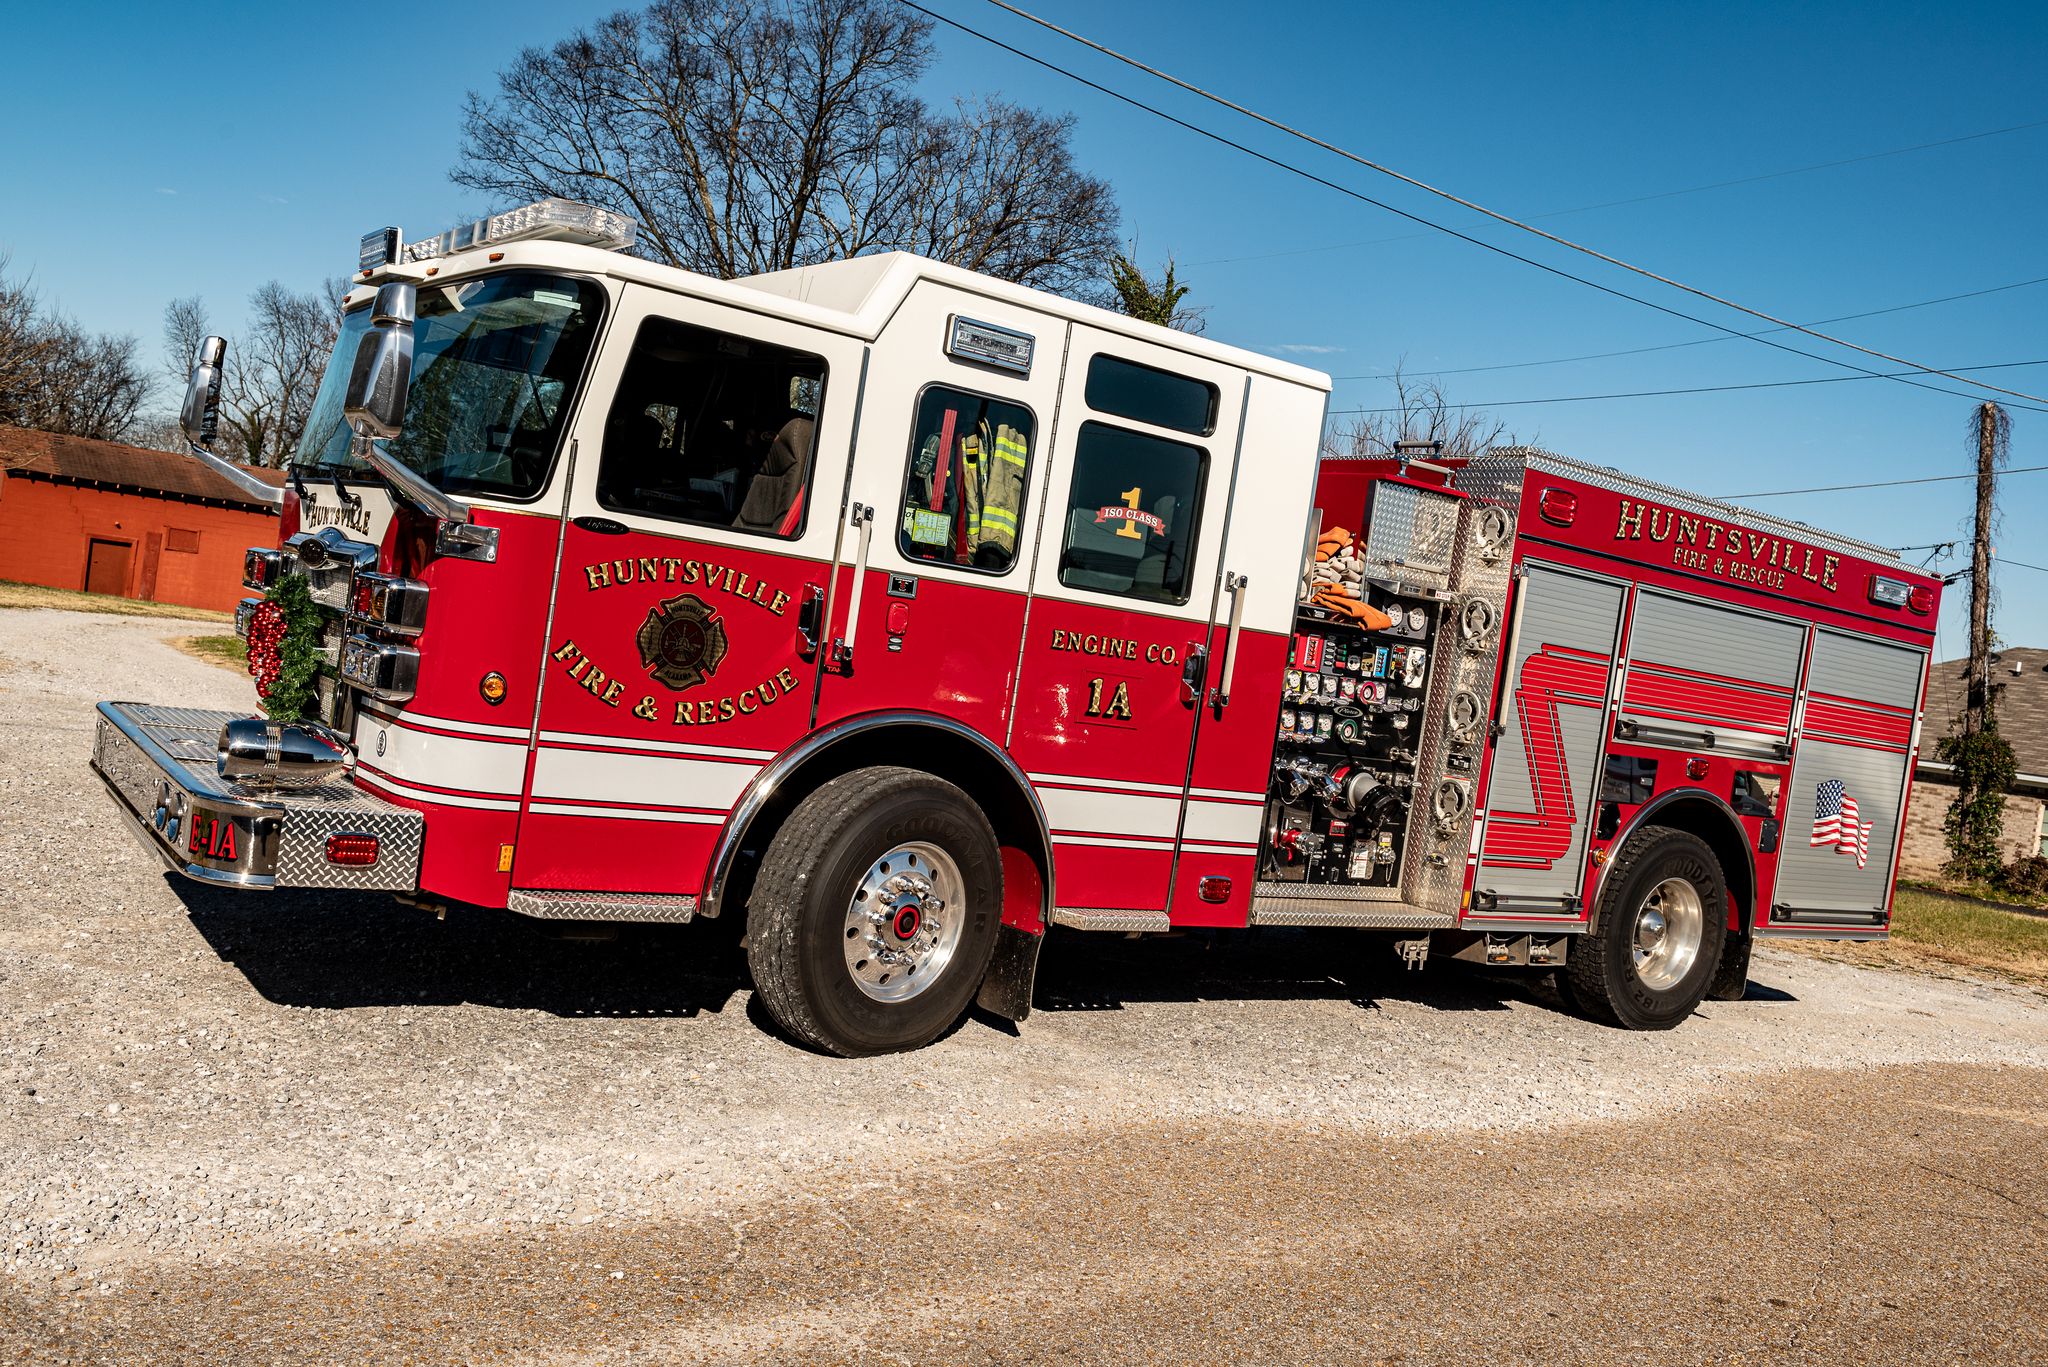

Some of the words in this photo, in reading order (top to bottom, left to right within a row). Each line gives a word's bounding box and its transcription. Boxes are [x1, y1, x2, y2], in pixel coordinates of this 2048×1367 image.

[309, 505, 371, 537] HUNTSVILLE
[1104, 508, 1123, 518] ISO
[1126, 508, 1158, 527] CLASS
[1116, 487, 1142, 539] 1
[1615, 500, 1840, 592] HUNTSVILLE
[1672, 546, 1707, 571] FIRE
[1712, 557, 1724, 576] &
[1730, 561, 1785, 591] RESCUE
[585, 557, 791, 617] HUNTSVILLE
[671, 604, 705, 616] HUNTSVILLE
[1051, 629, 1138, 660] ENGINE
[1145, 643, 1179, 666] CO.
[552, 640, 626, 707] FIRE
[632, 695, 658, 721] &
[672, 667, 799, 725] RESCUE
[1085, 677, 1132, 721] 1A
[188, 814, 238, 863] E-1A
[887, 816, 988, 934] GOODYAR
